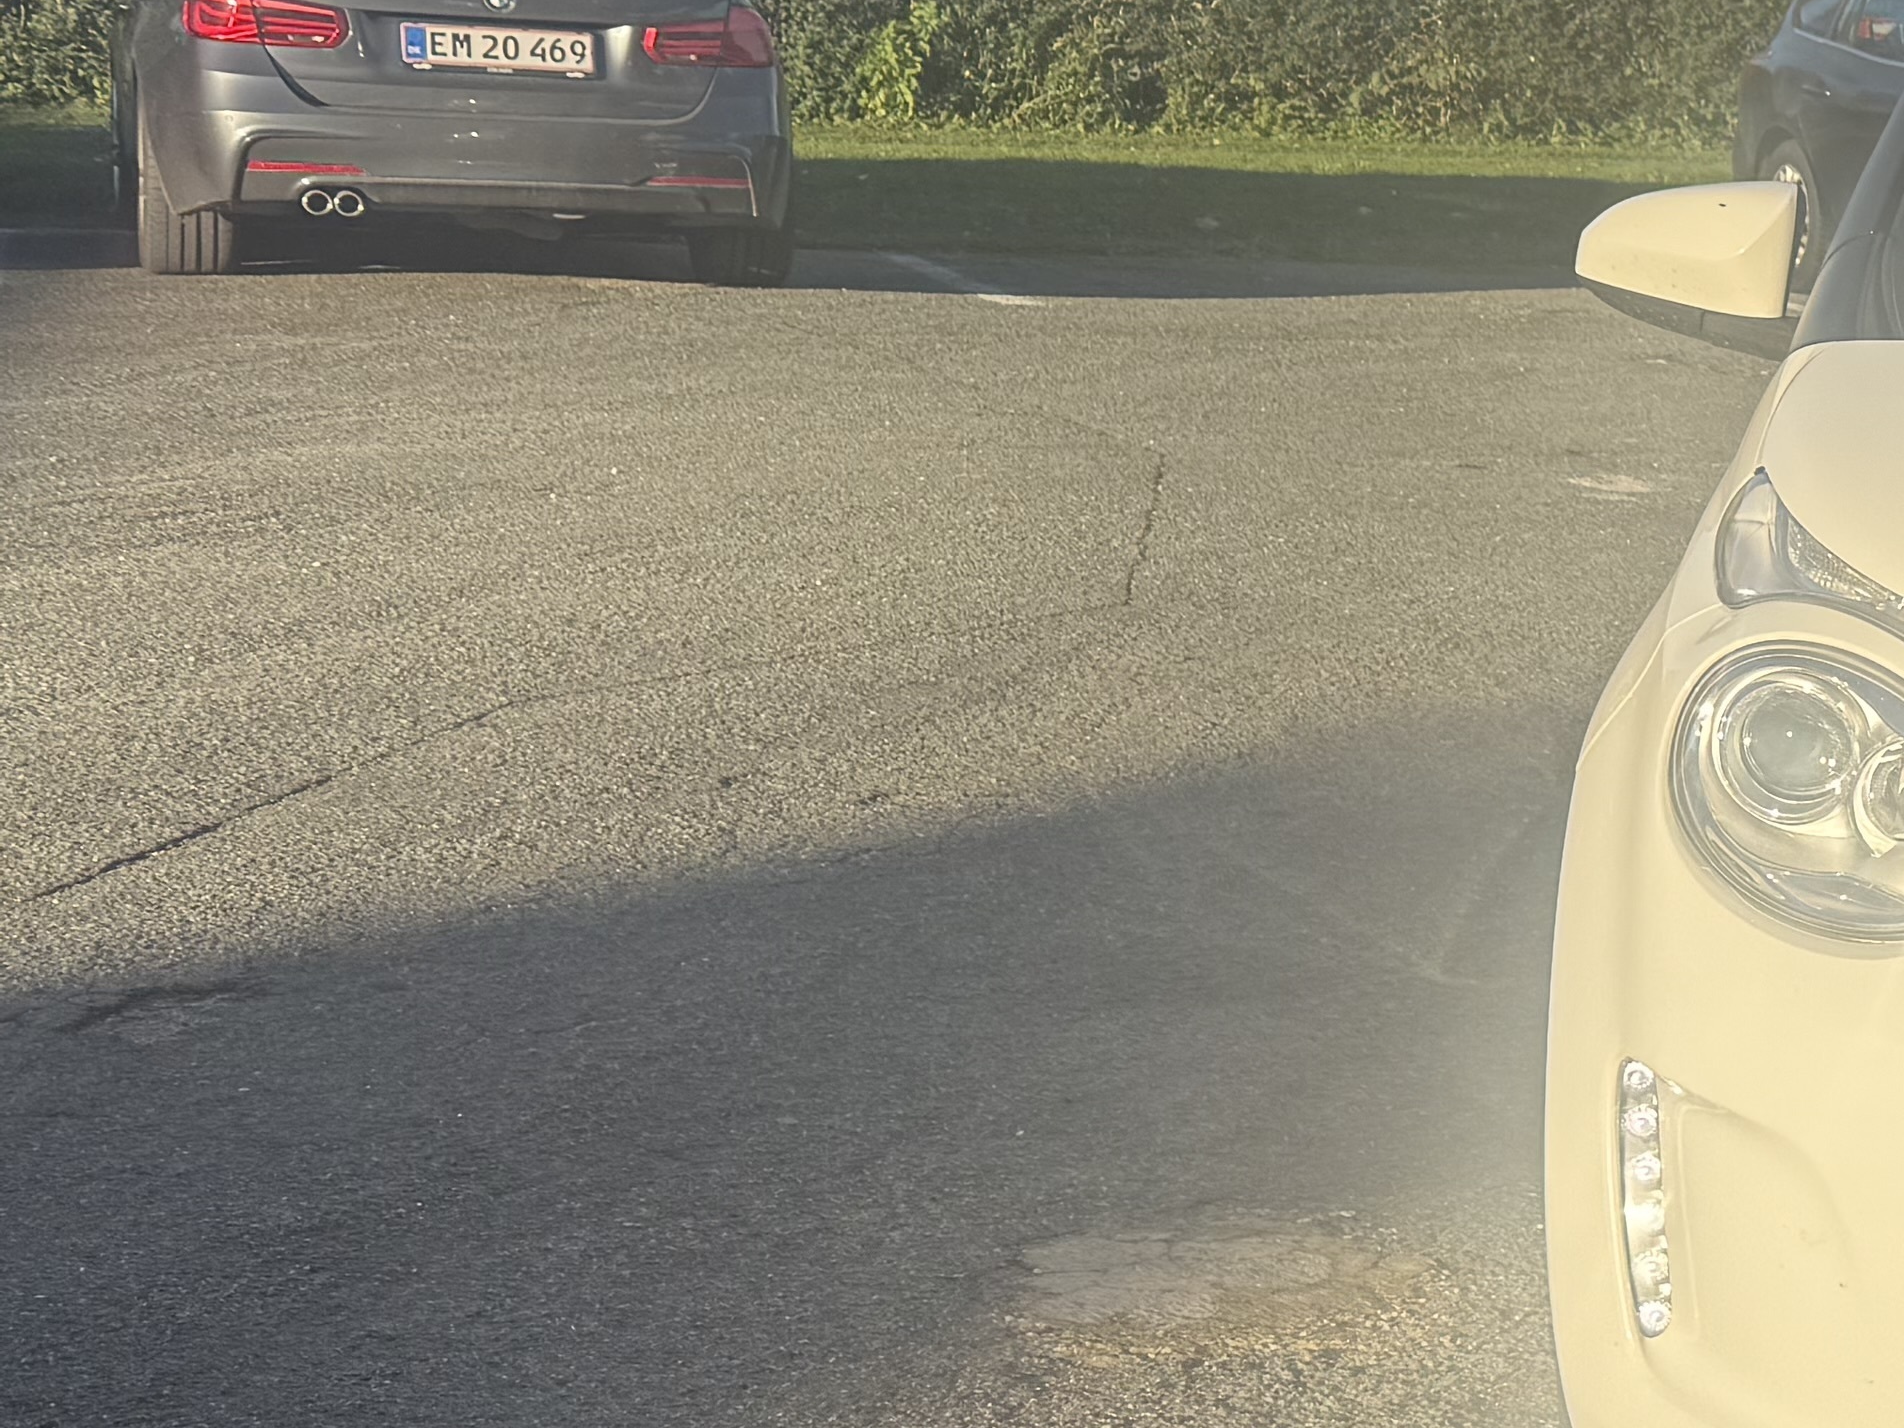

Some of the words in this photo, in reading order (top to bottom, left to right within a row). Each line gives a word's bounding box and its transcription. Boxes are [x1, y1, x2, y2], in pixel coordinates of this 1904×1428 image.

[430, 32, 473, 59] EM
[481, 34, 520, 61] 20
[529, 37, 587, 65] 469
